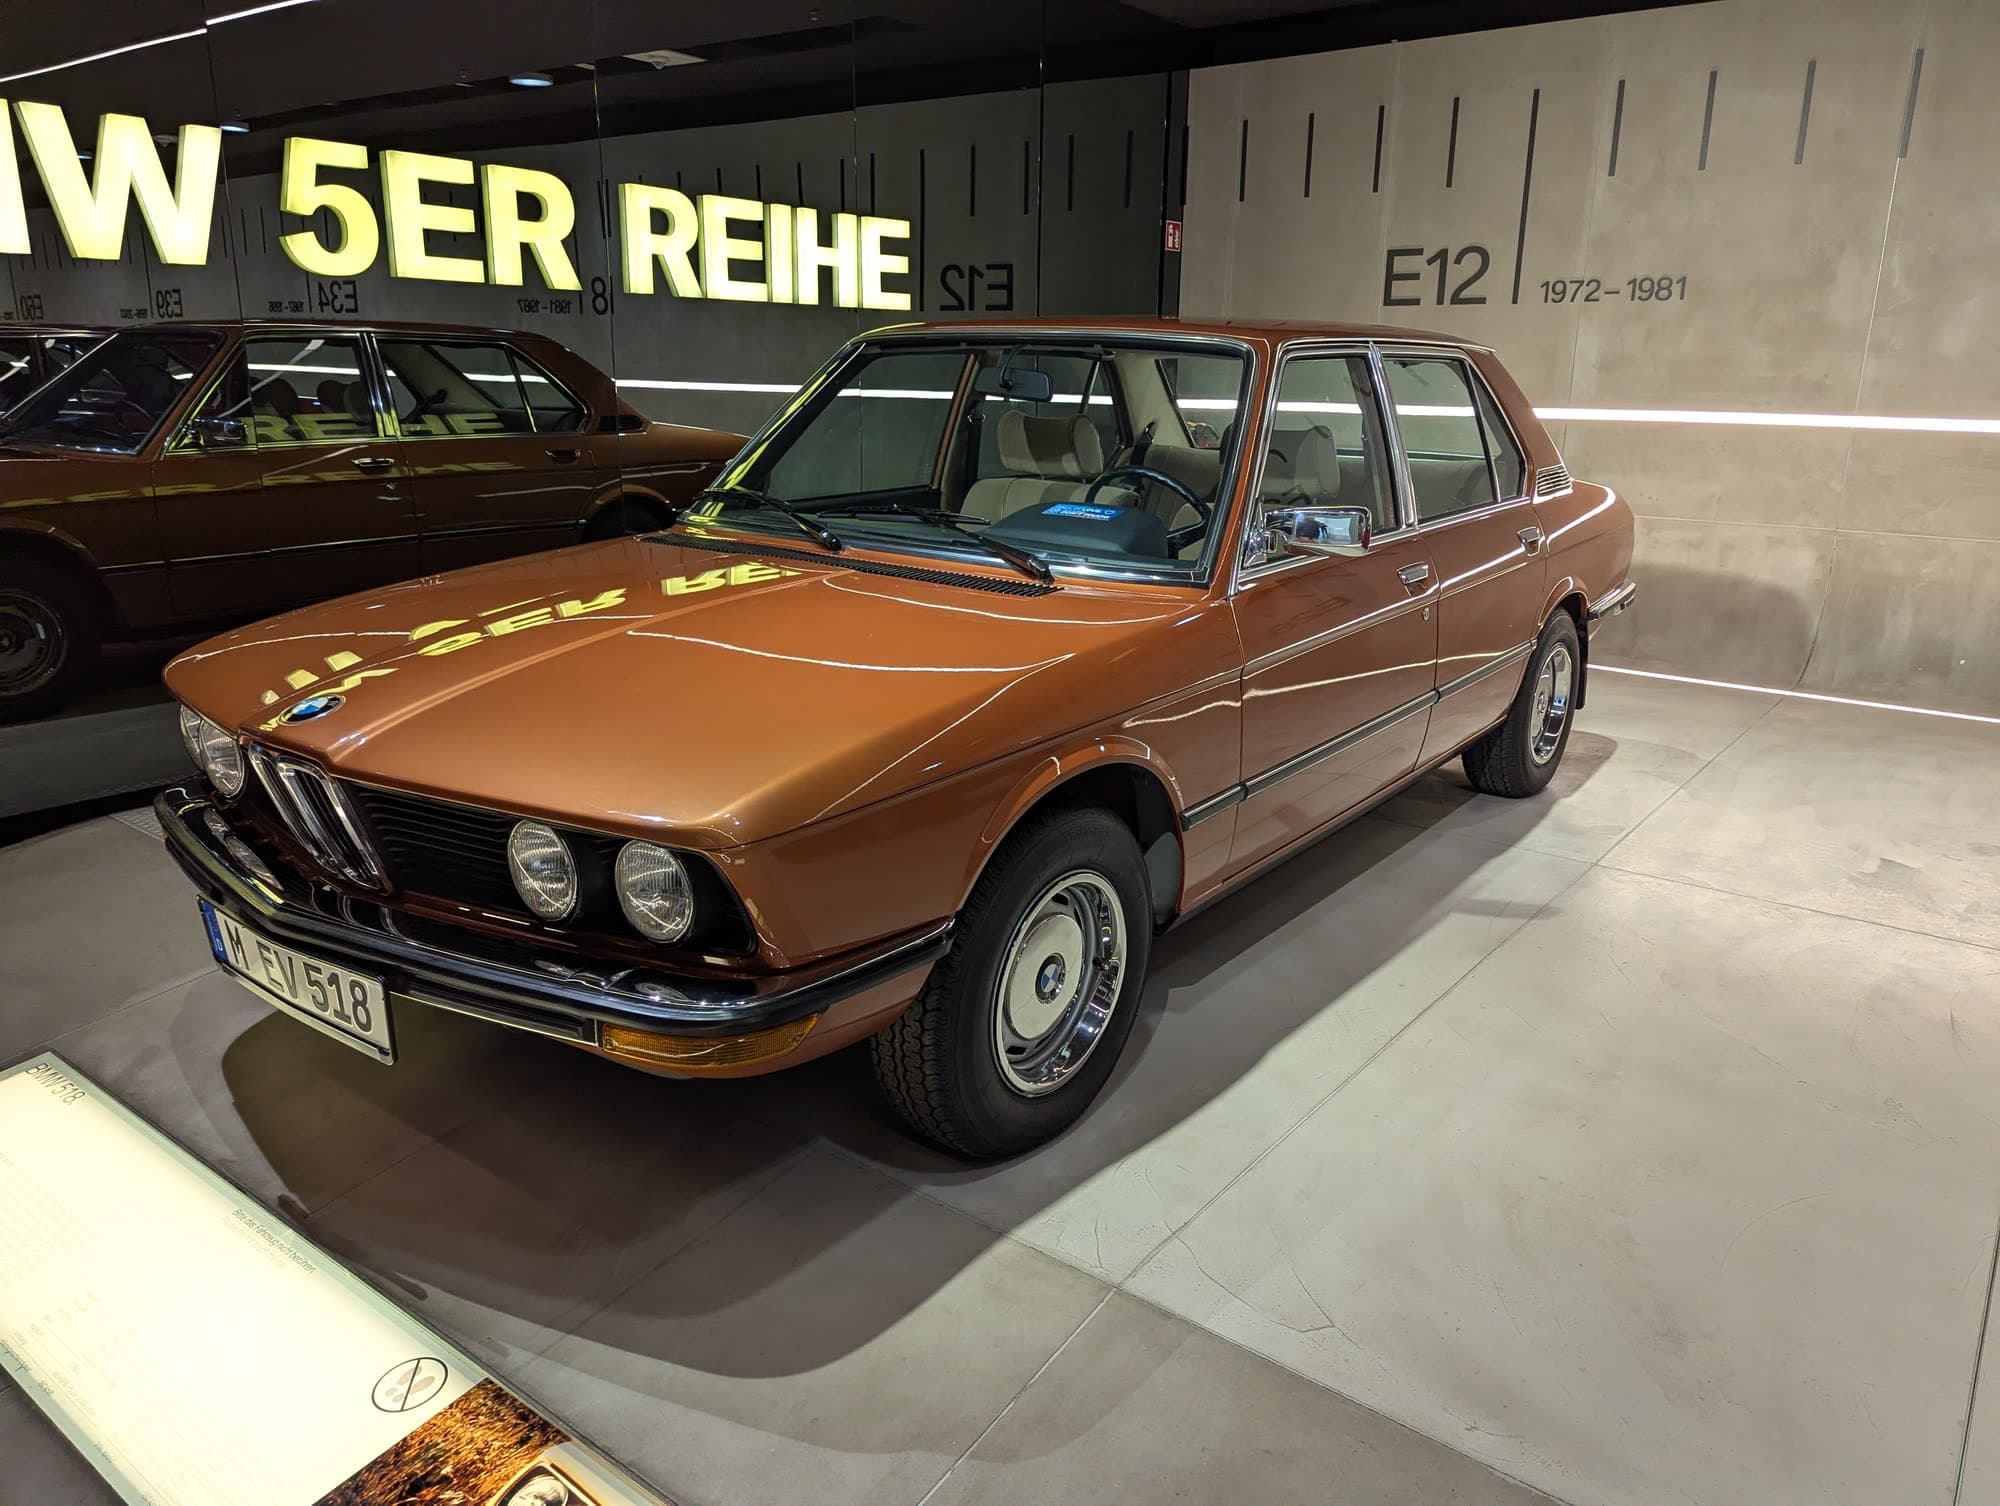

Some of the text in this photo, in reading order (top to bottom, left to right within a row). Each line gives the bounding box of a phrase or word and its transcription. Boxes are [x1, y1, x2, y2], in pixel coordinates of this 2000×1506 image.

[0, 98, 912, 311] W 5ER REIHE
[1384, 246, 1490, 306] E12
[224, 918, 373, 1034] M EV 518
[24, 1062, 68, 1089] BMW
